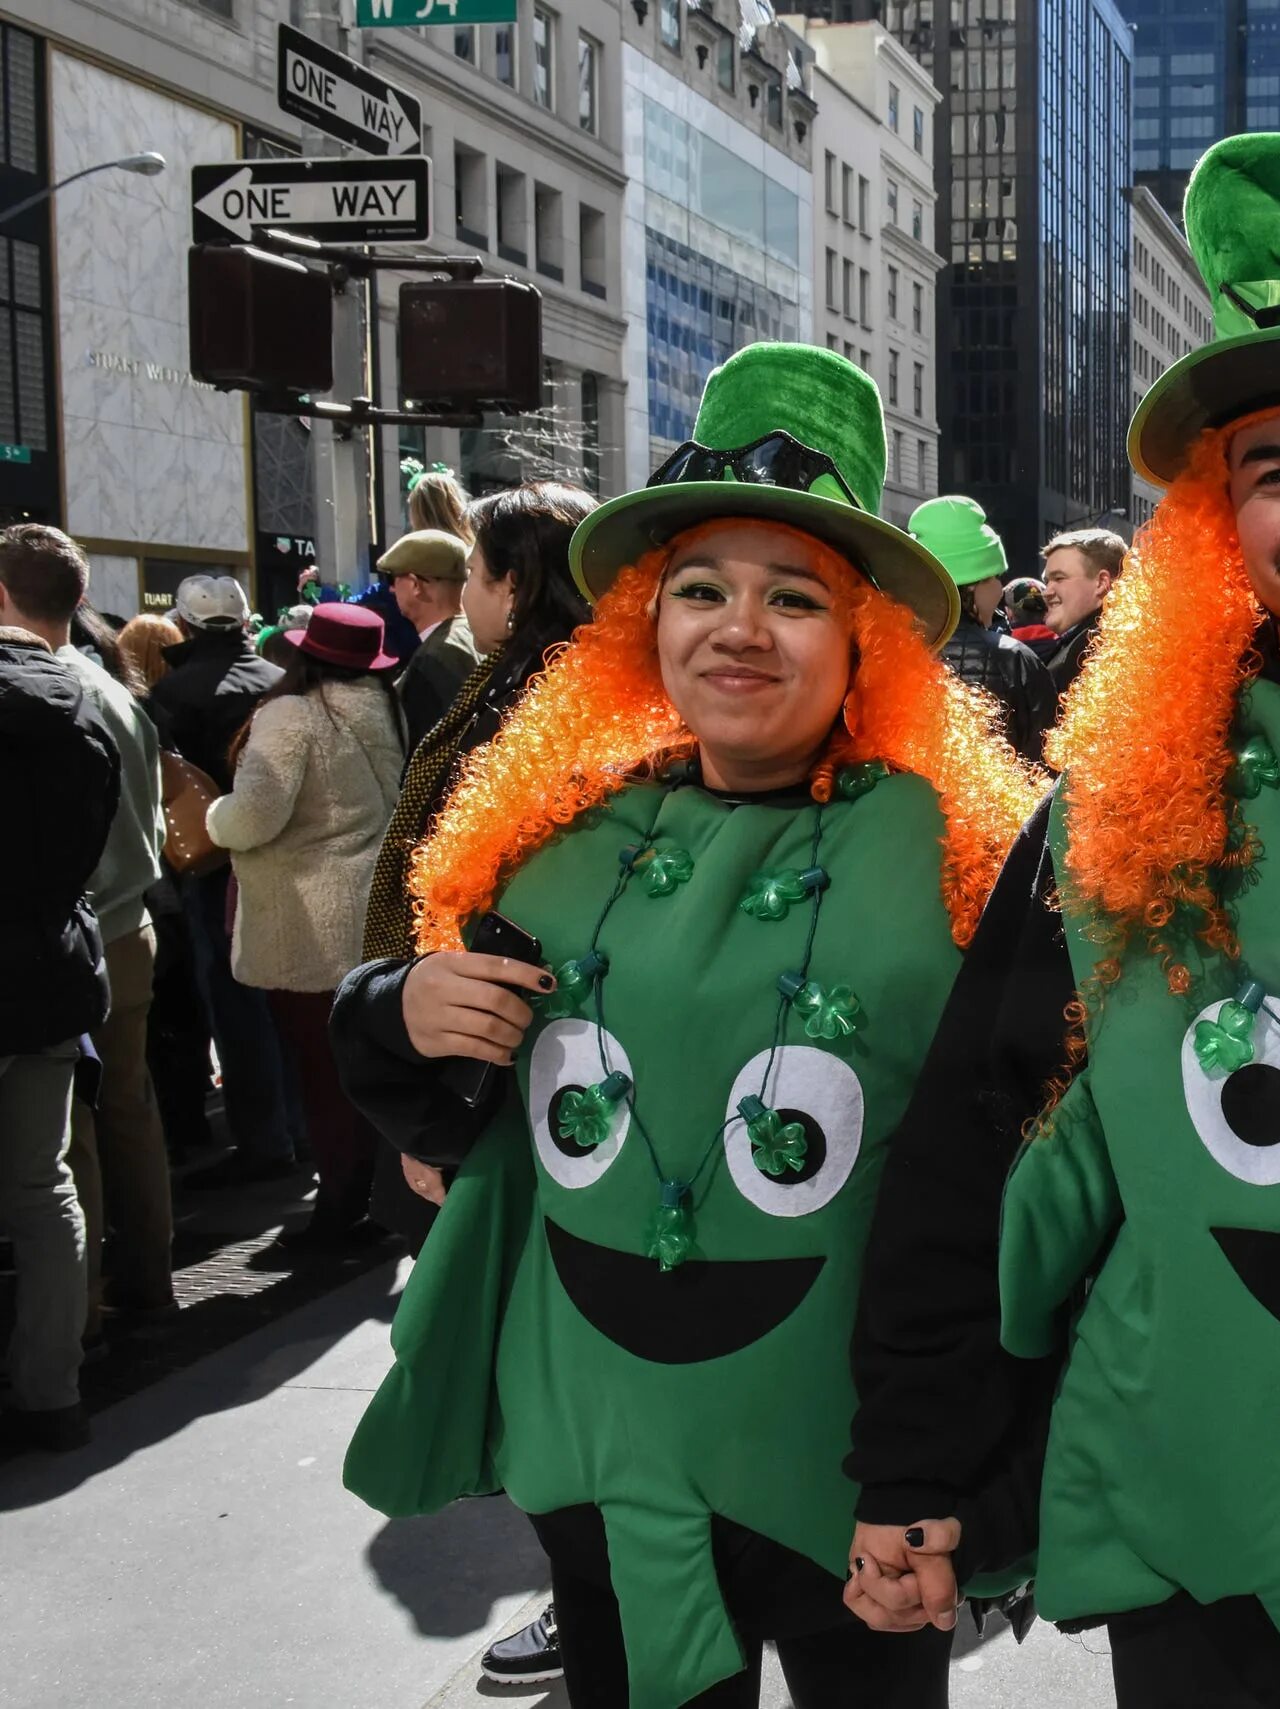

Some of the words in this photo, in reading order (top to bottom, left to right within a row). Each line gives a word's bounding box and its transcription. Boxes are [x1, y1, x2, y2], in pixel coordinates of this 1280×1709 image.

[292, 59, 337, 110] ONE
[361, 94, 404, 143] WAY
[222, 188, 291, 220] ONE
[332, 184, 407, 217] WAY
